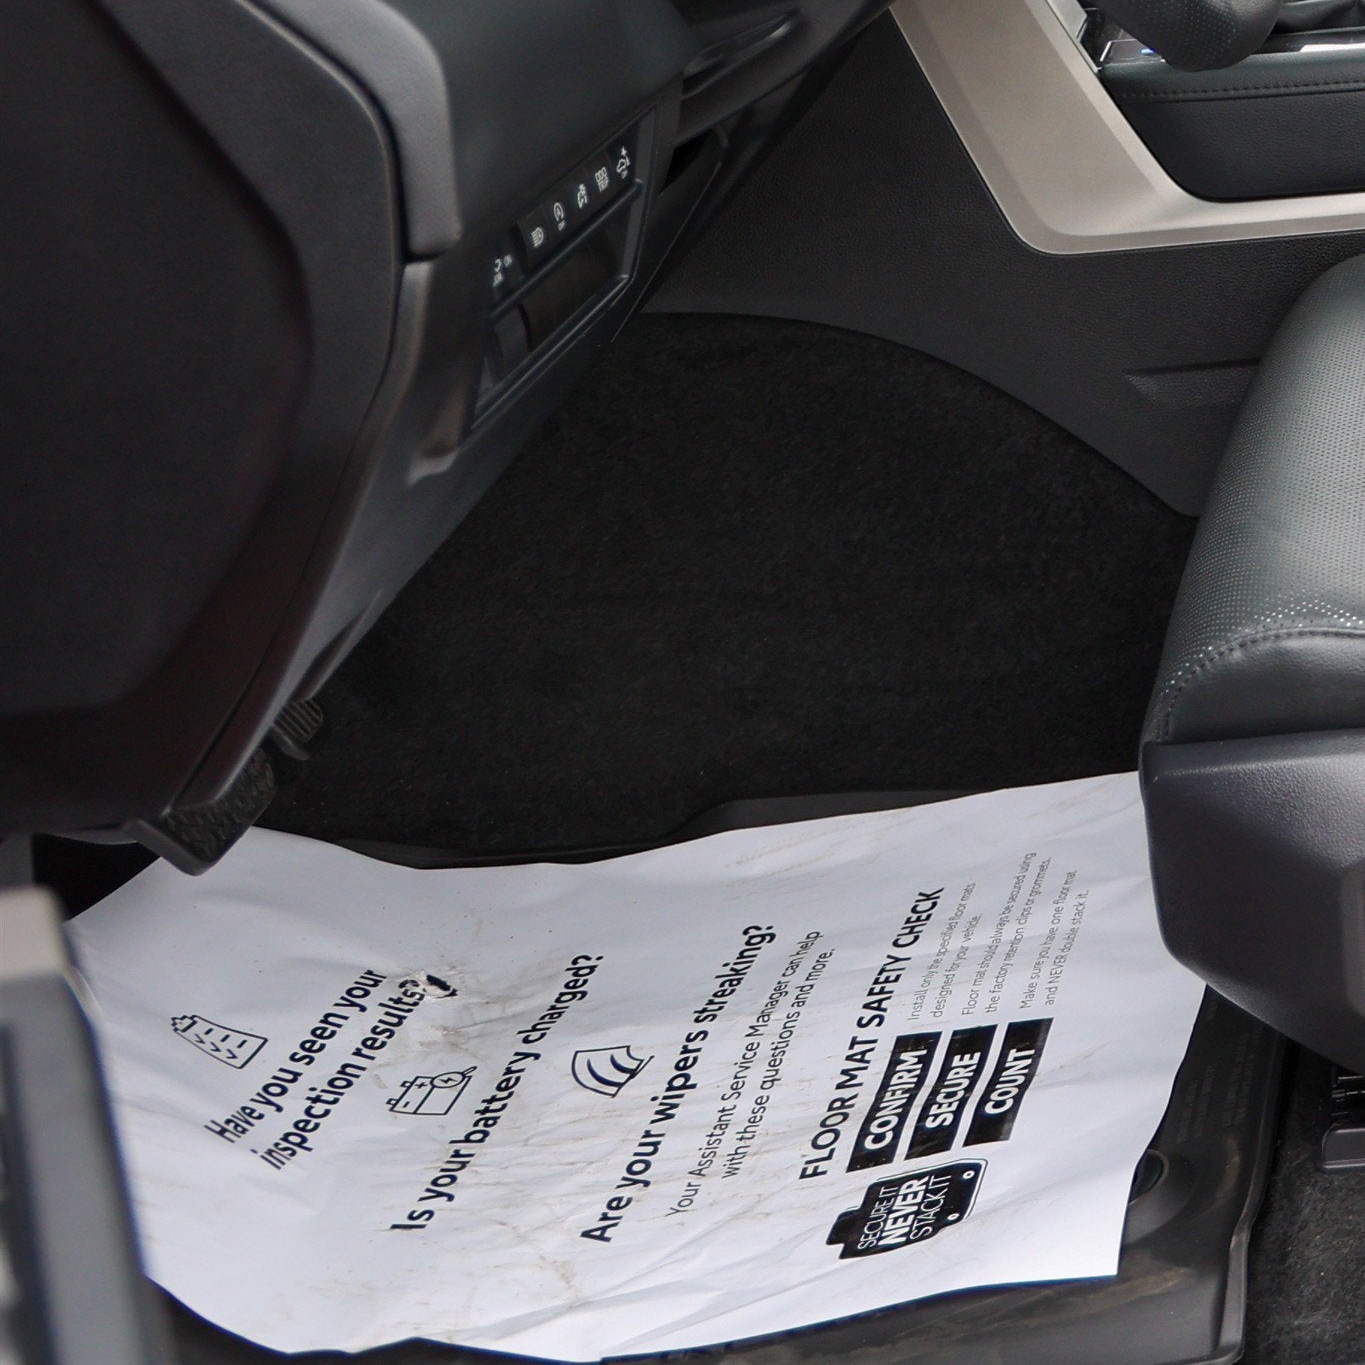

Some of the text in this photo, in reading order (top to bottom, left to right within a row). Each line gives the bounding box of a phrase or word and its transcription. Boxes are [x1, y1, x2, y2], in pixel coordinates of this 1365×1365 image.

[1071, 902, 1085, 925] stack
[931, 974, 955, 1017] designed
[961, 989, 979, 1015] Floor
[990, 914, 1009, 946] always
[989, 963, 1013, 993] factory
[1019, 983, 1037, 1009] Make
[1051, 907, 1064, 924] one
[1045, 983, 1058, 1005] and
[1048, 954, 1068, 983] NEVER
[799, 888, 944, 1179] FLOOR MAT SAFETY CHECK
[907, 989, 928, 1020] Install
[204, 970, 387, 1143] Have you seen your
[391, 955, 603, 1230] Is your battery charged?
[580, 926, 776, 1242] Are your wipers streaking?
[665, 932, 823, 1216] Your Assistant Service Manager can help
[722, 949, 835, 1178] with these questions and more.
[925, 1052, 980, 1128] SECURE
[985, 1049, 1035, 1114] COUNT
[251, 1063, 366, 1169] inspection
[865, 1050, 927, 1149] CONFIRM
[857, 1187, 898, 1249] SECURE IT
[878, 1176, 929, 1245] NEVER
[910, 1175, 951, 1239] STACK IT
